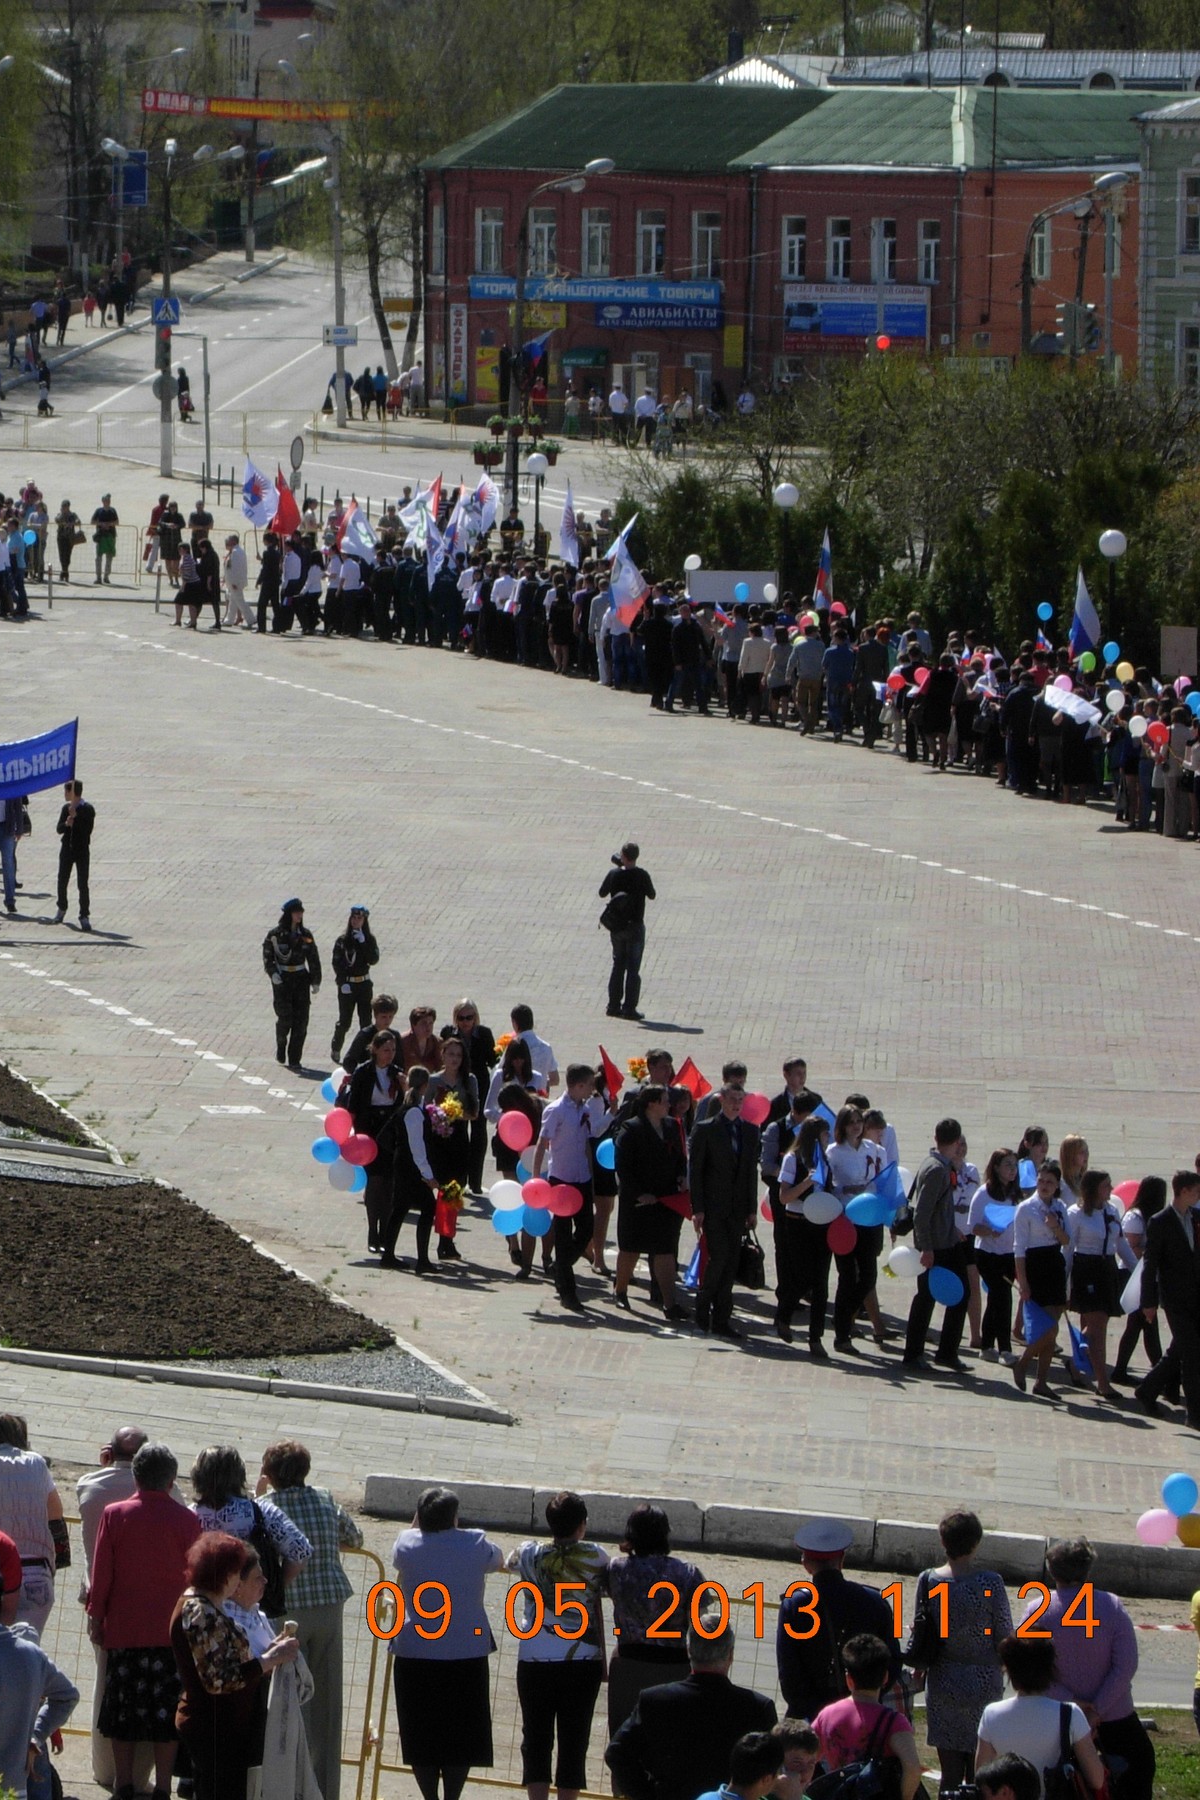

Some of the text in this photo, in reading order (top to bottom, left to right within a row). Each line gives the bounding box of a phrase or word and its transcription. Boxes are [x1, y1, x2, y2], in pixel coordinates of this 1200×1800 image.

[146, 91, 155, 107] 9
[158, 92, 191, 111] МАЯ
[659, 286, 714, 300] ТОВАРЫ
[629, 306, 717, 319] АВИАБИЛЕТЫ
[690, 320, 717, 328] КАССЫ
